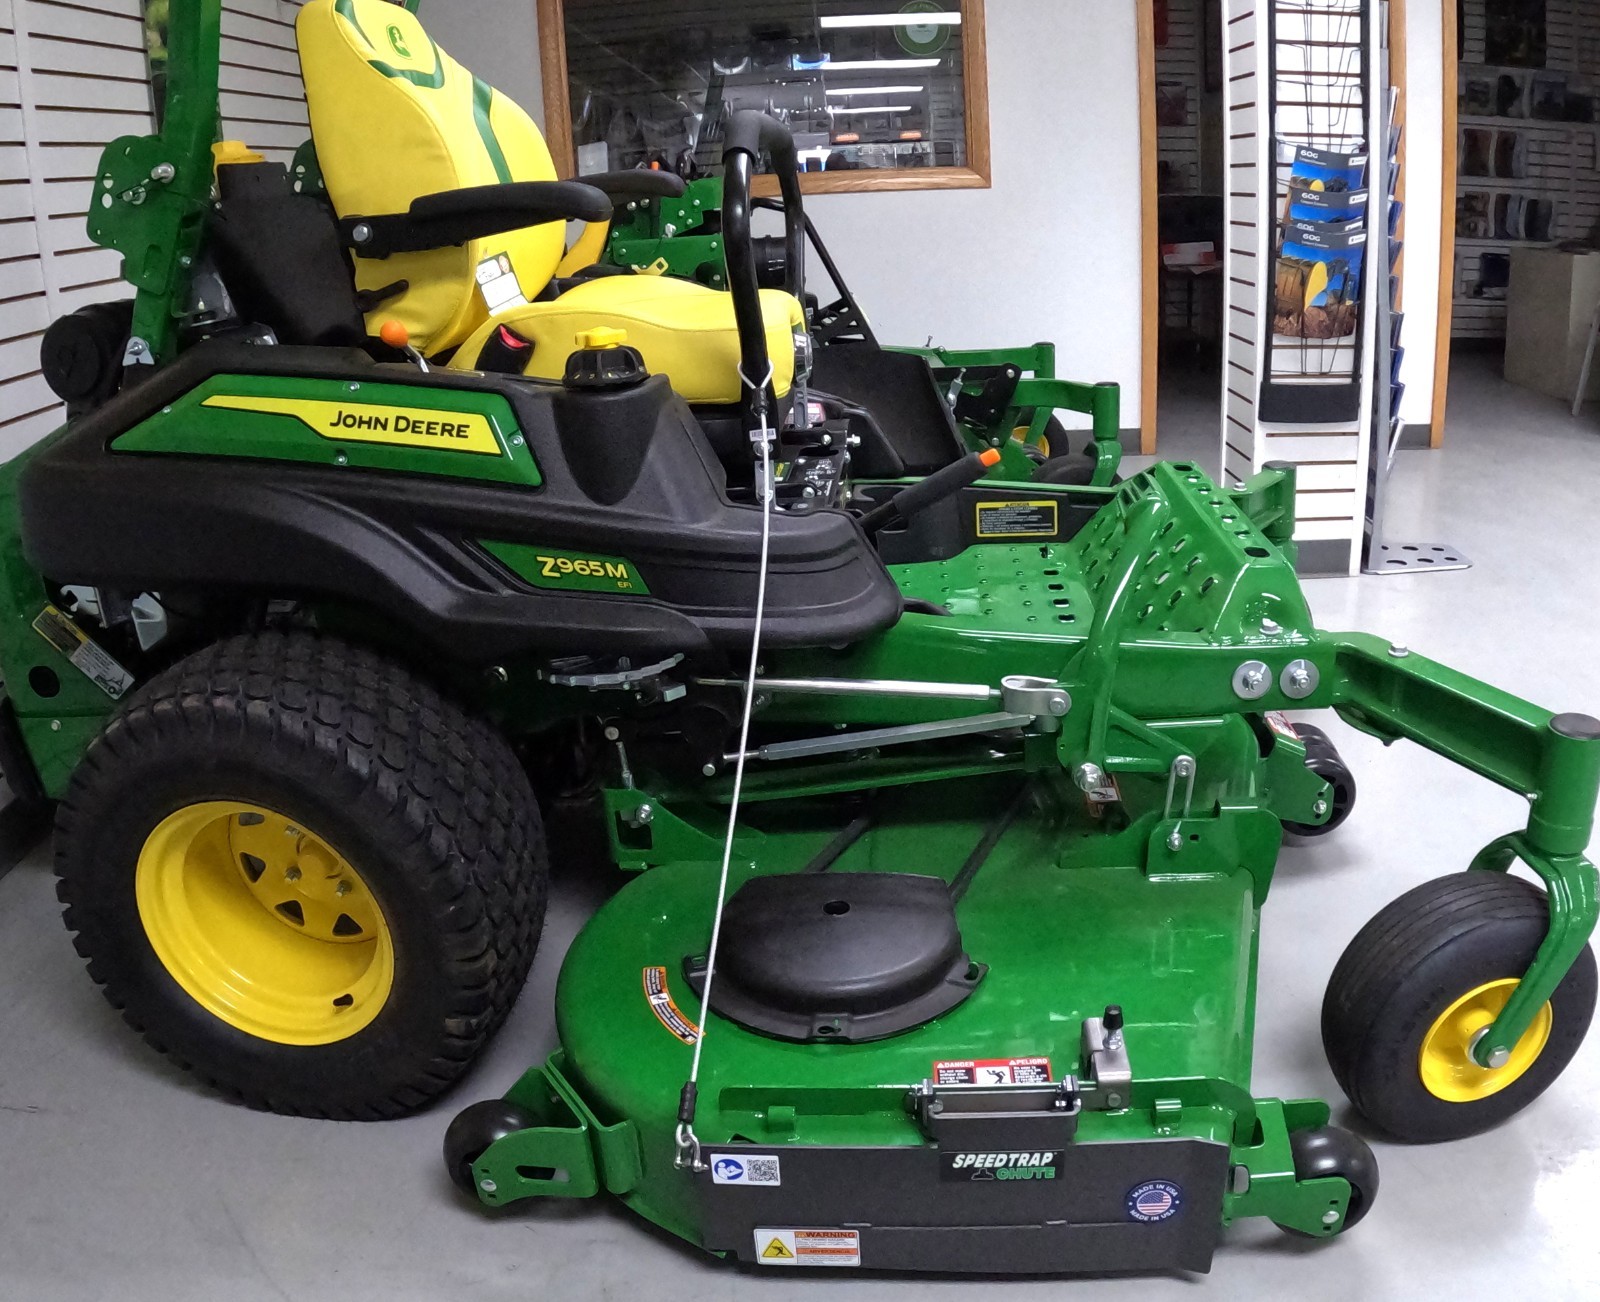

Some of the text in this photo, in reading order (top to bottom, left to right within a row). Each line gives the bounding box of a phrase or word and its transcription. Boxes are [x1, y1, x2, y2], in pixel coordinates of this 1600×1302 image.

[1301, 192, 1320, 201] 60G
[1302, 233, 1321, 242] 60G
[329, 410, 470, 439] JOHN DEERE
[536, 556, 629, 579] Z965M
[617, 581, 633, 589] EFI
[952, 1152, 1054, 1168] SPEEDTRAP
[996, 1166, 1056, 1180] CHUTE
[1132, 1184, 1155, 1198] MADE
[1165, 1185, 1179, 1197] USA
[1129, 1209, 1150, 1221] MADE
[1160, 1209, 1176, 1219] USA
